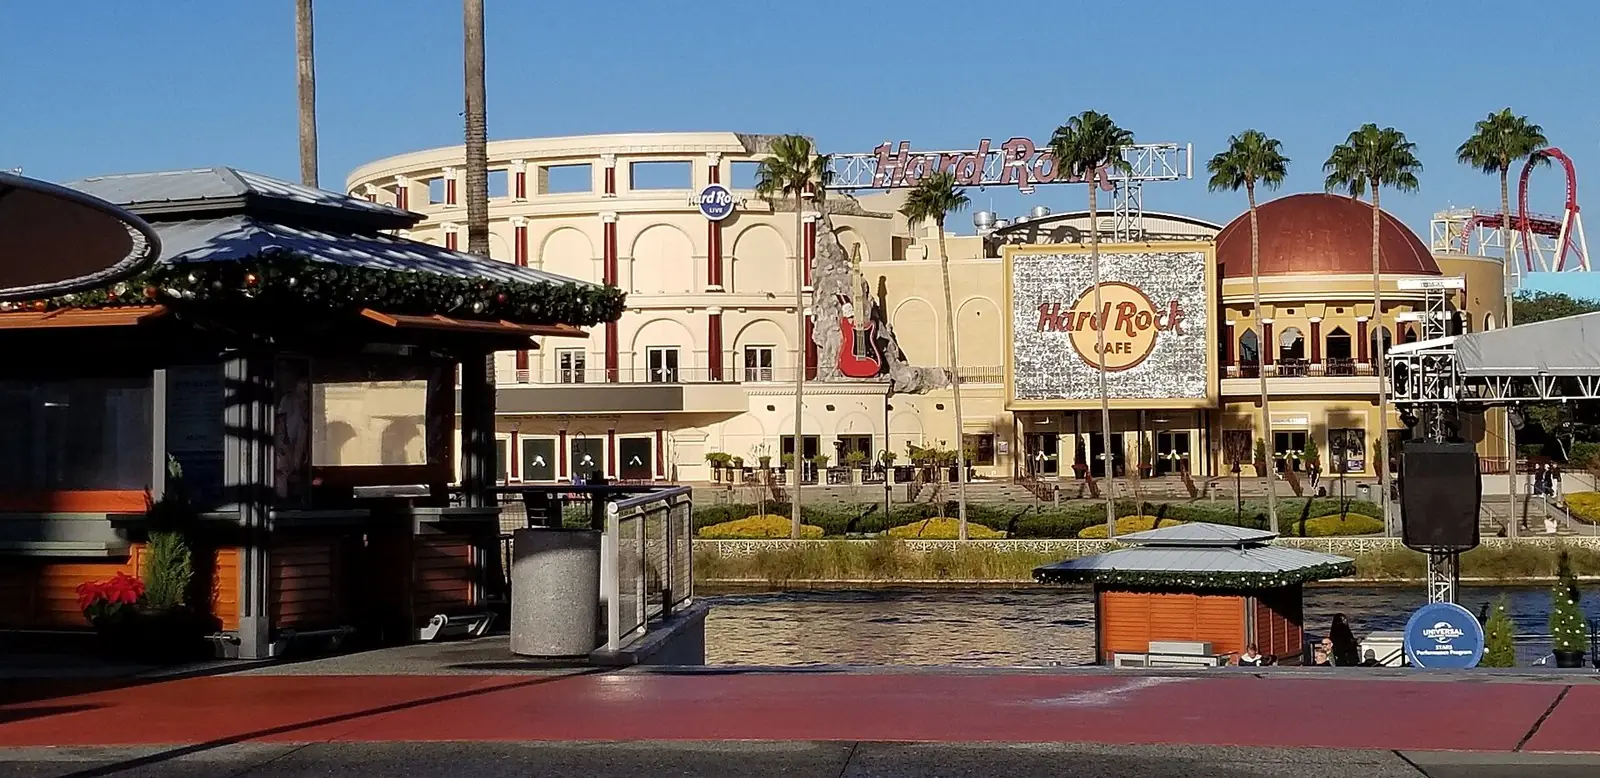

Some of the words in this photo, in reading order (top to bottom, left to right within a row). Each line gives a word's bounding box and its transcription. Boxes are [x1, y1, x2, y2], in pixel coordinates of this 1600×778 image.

[872, 139, 991, 188] Hard
[687, 190, 715, 205] Hard
[716, 190, 746, 208] Rock
[1037, 302, 1110, 332] Hard
[1115, 300, 1185, 337] Rock
[1094, 342, 1132, 354] CAFE
[1422, 628, 1464, 636] UNIVERSAL
